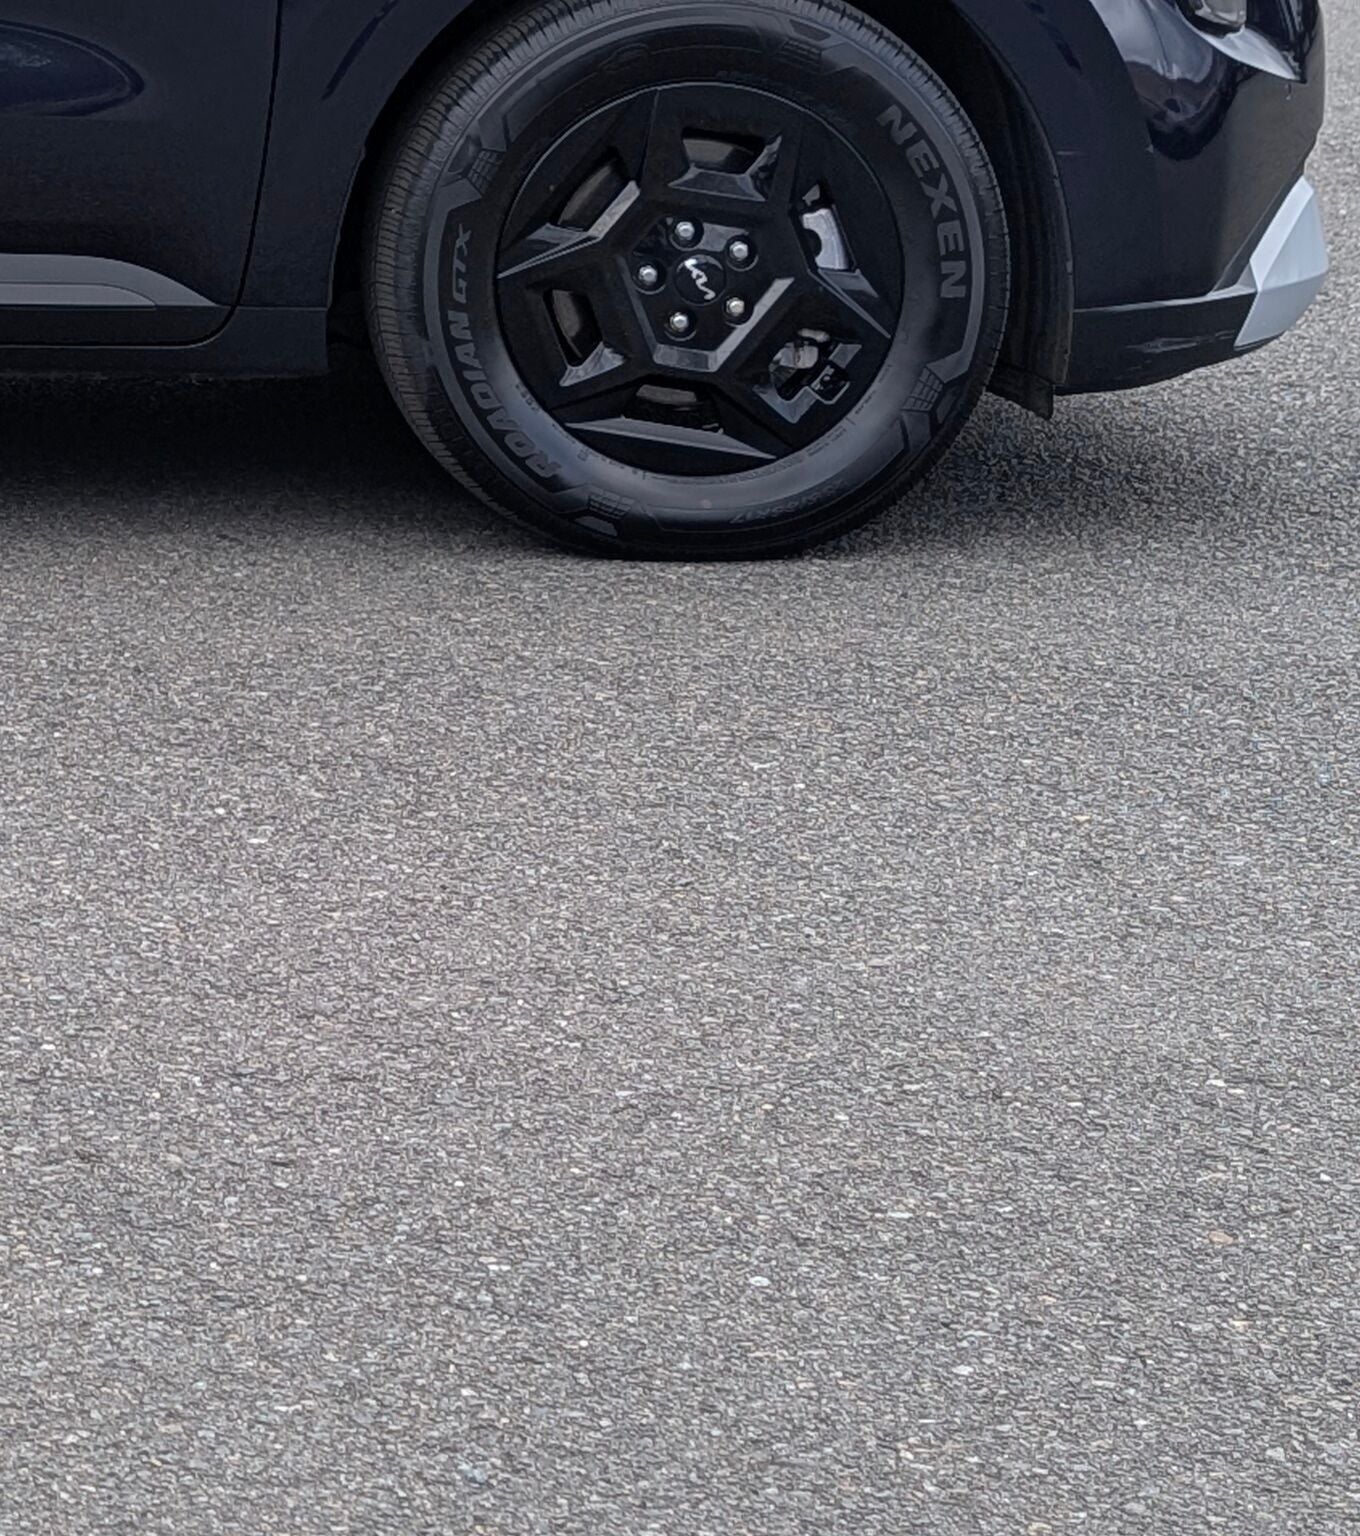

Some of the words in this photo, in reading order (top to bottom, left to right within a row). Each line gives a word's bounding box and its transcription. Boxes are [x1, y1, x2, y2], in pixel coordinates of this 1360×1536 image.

[452, 223, 472, 305] GTX
[875, 103, 967, 299] NEXEN
[447, 309, 563, 479] ROADIAN
